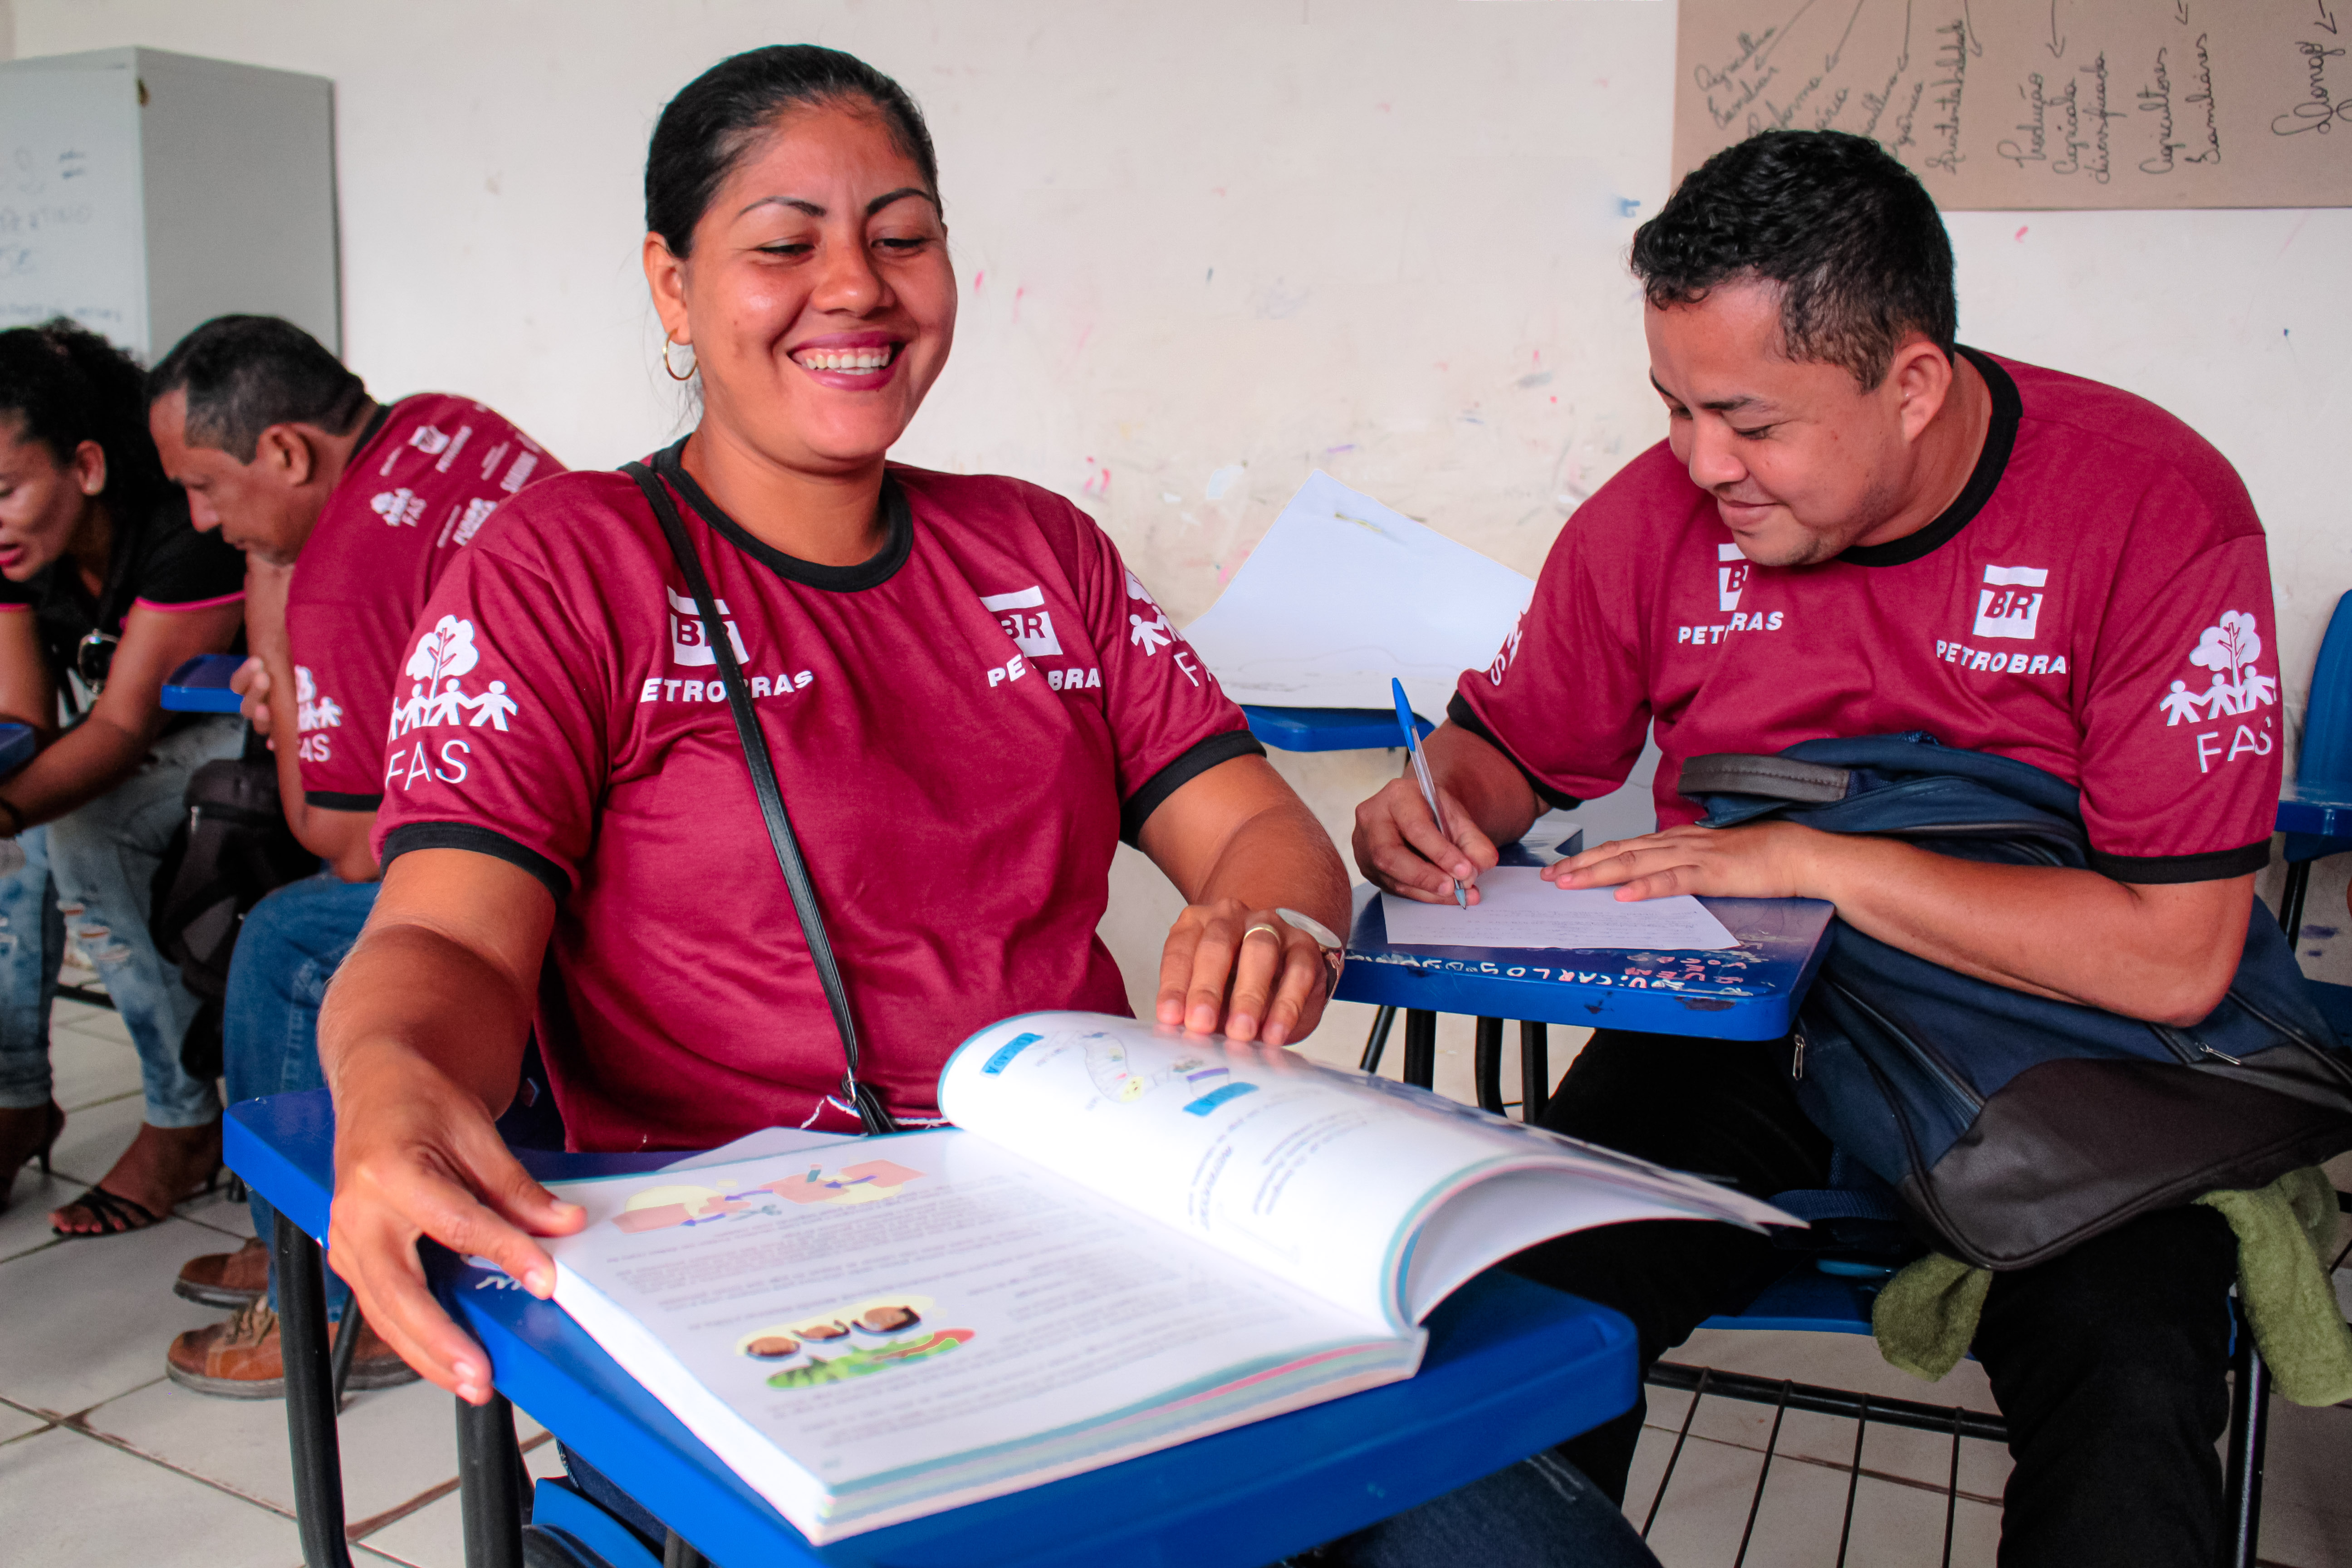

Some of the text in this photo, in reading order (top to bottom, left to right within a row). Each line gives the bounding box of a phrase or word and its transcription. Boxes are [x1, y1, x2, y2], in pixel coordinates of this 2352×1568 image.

[1983, 591, 2034, 620] BR
[1678, 611, 1784, 645] PETRAS
[1936, 639, 2068, 675] PETROBRA
[296, 733, 331, 762] AS
[385, 739, 471, 791] FAS
